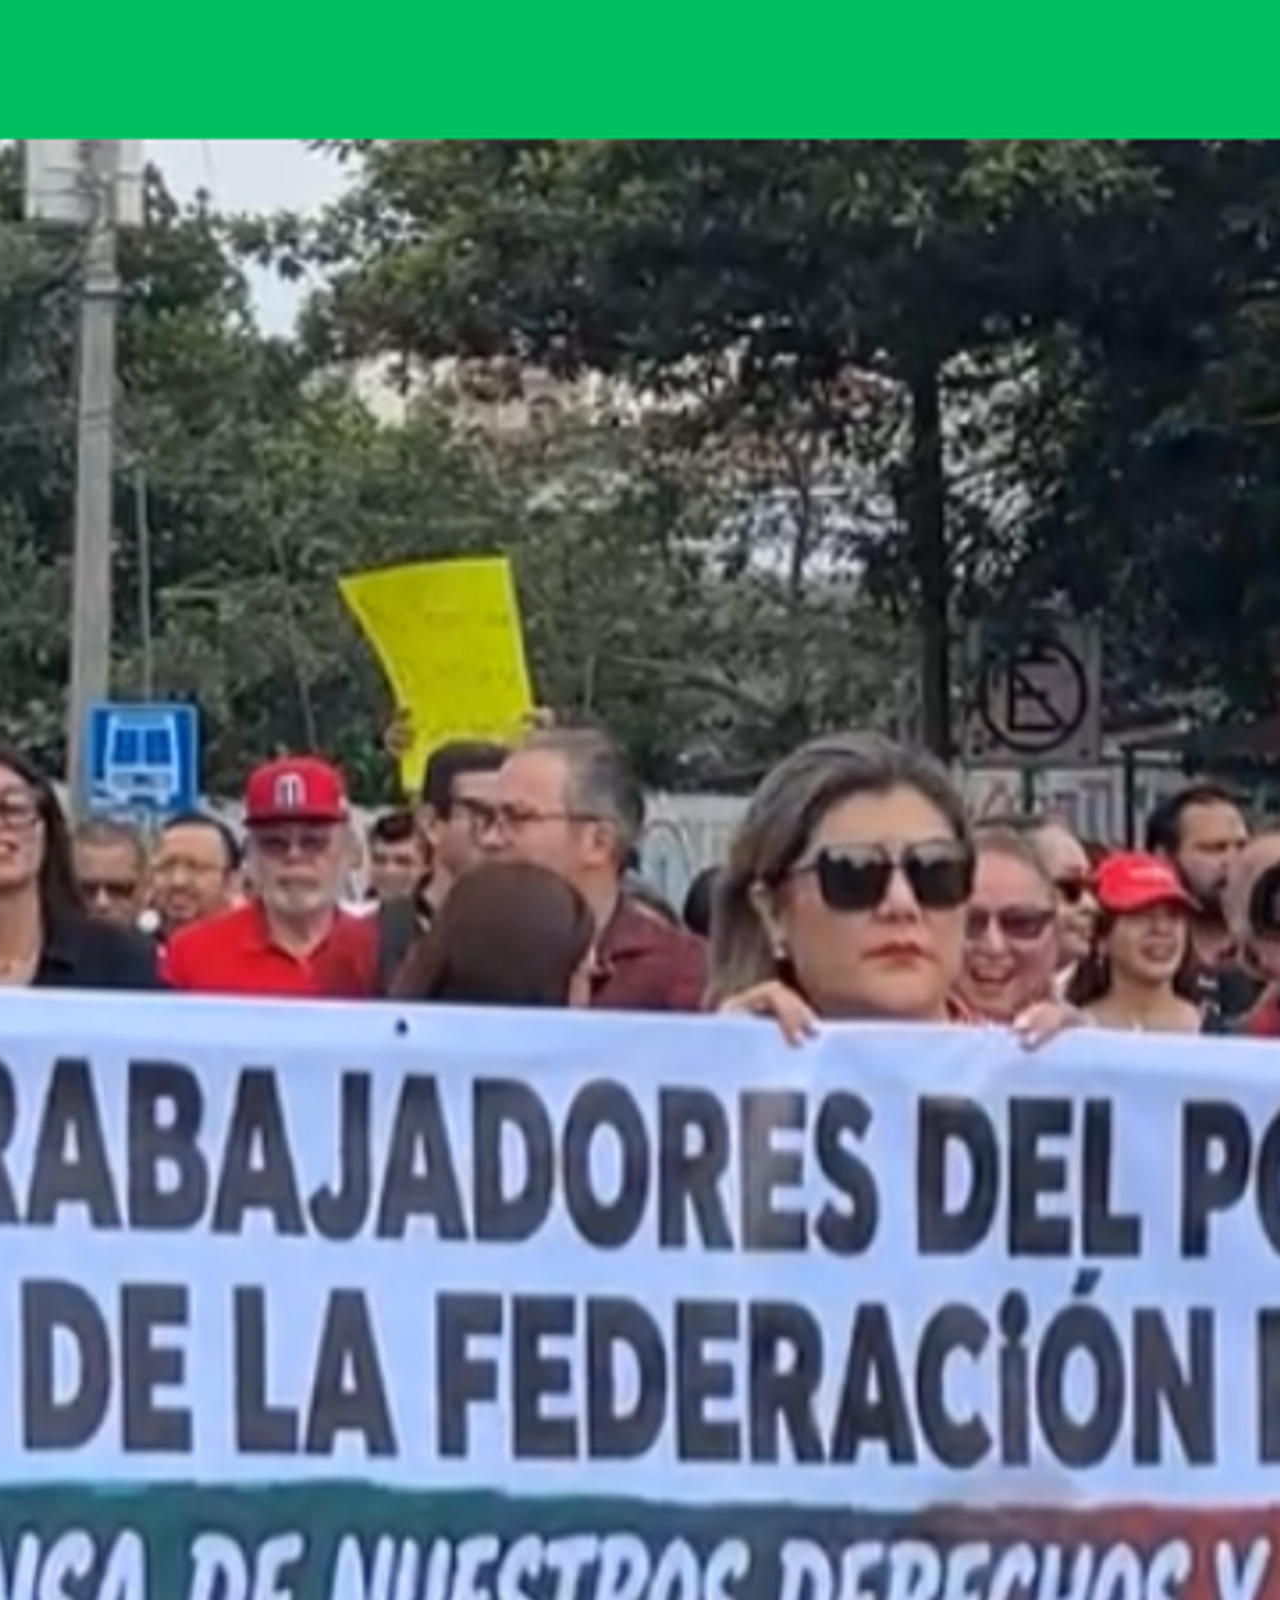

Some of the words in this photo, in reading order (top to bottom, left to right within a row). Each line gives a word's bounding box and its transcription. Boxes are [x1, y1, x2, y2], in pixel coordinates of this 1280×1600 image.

[916, 1096, 1141, 1258] DEL
[19, 1277, 193, 1454] DE
[232, 1285, 399, 1458] LA
